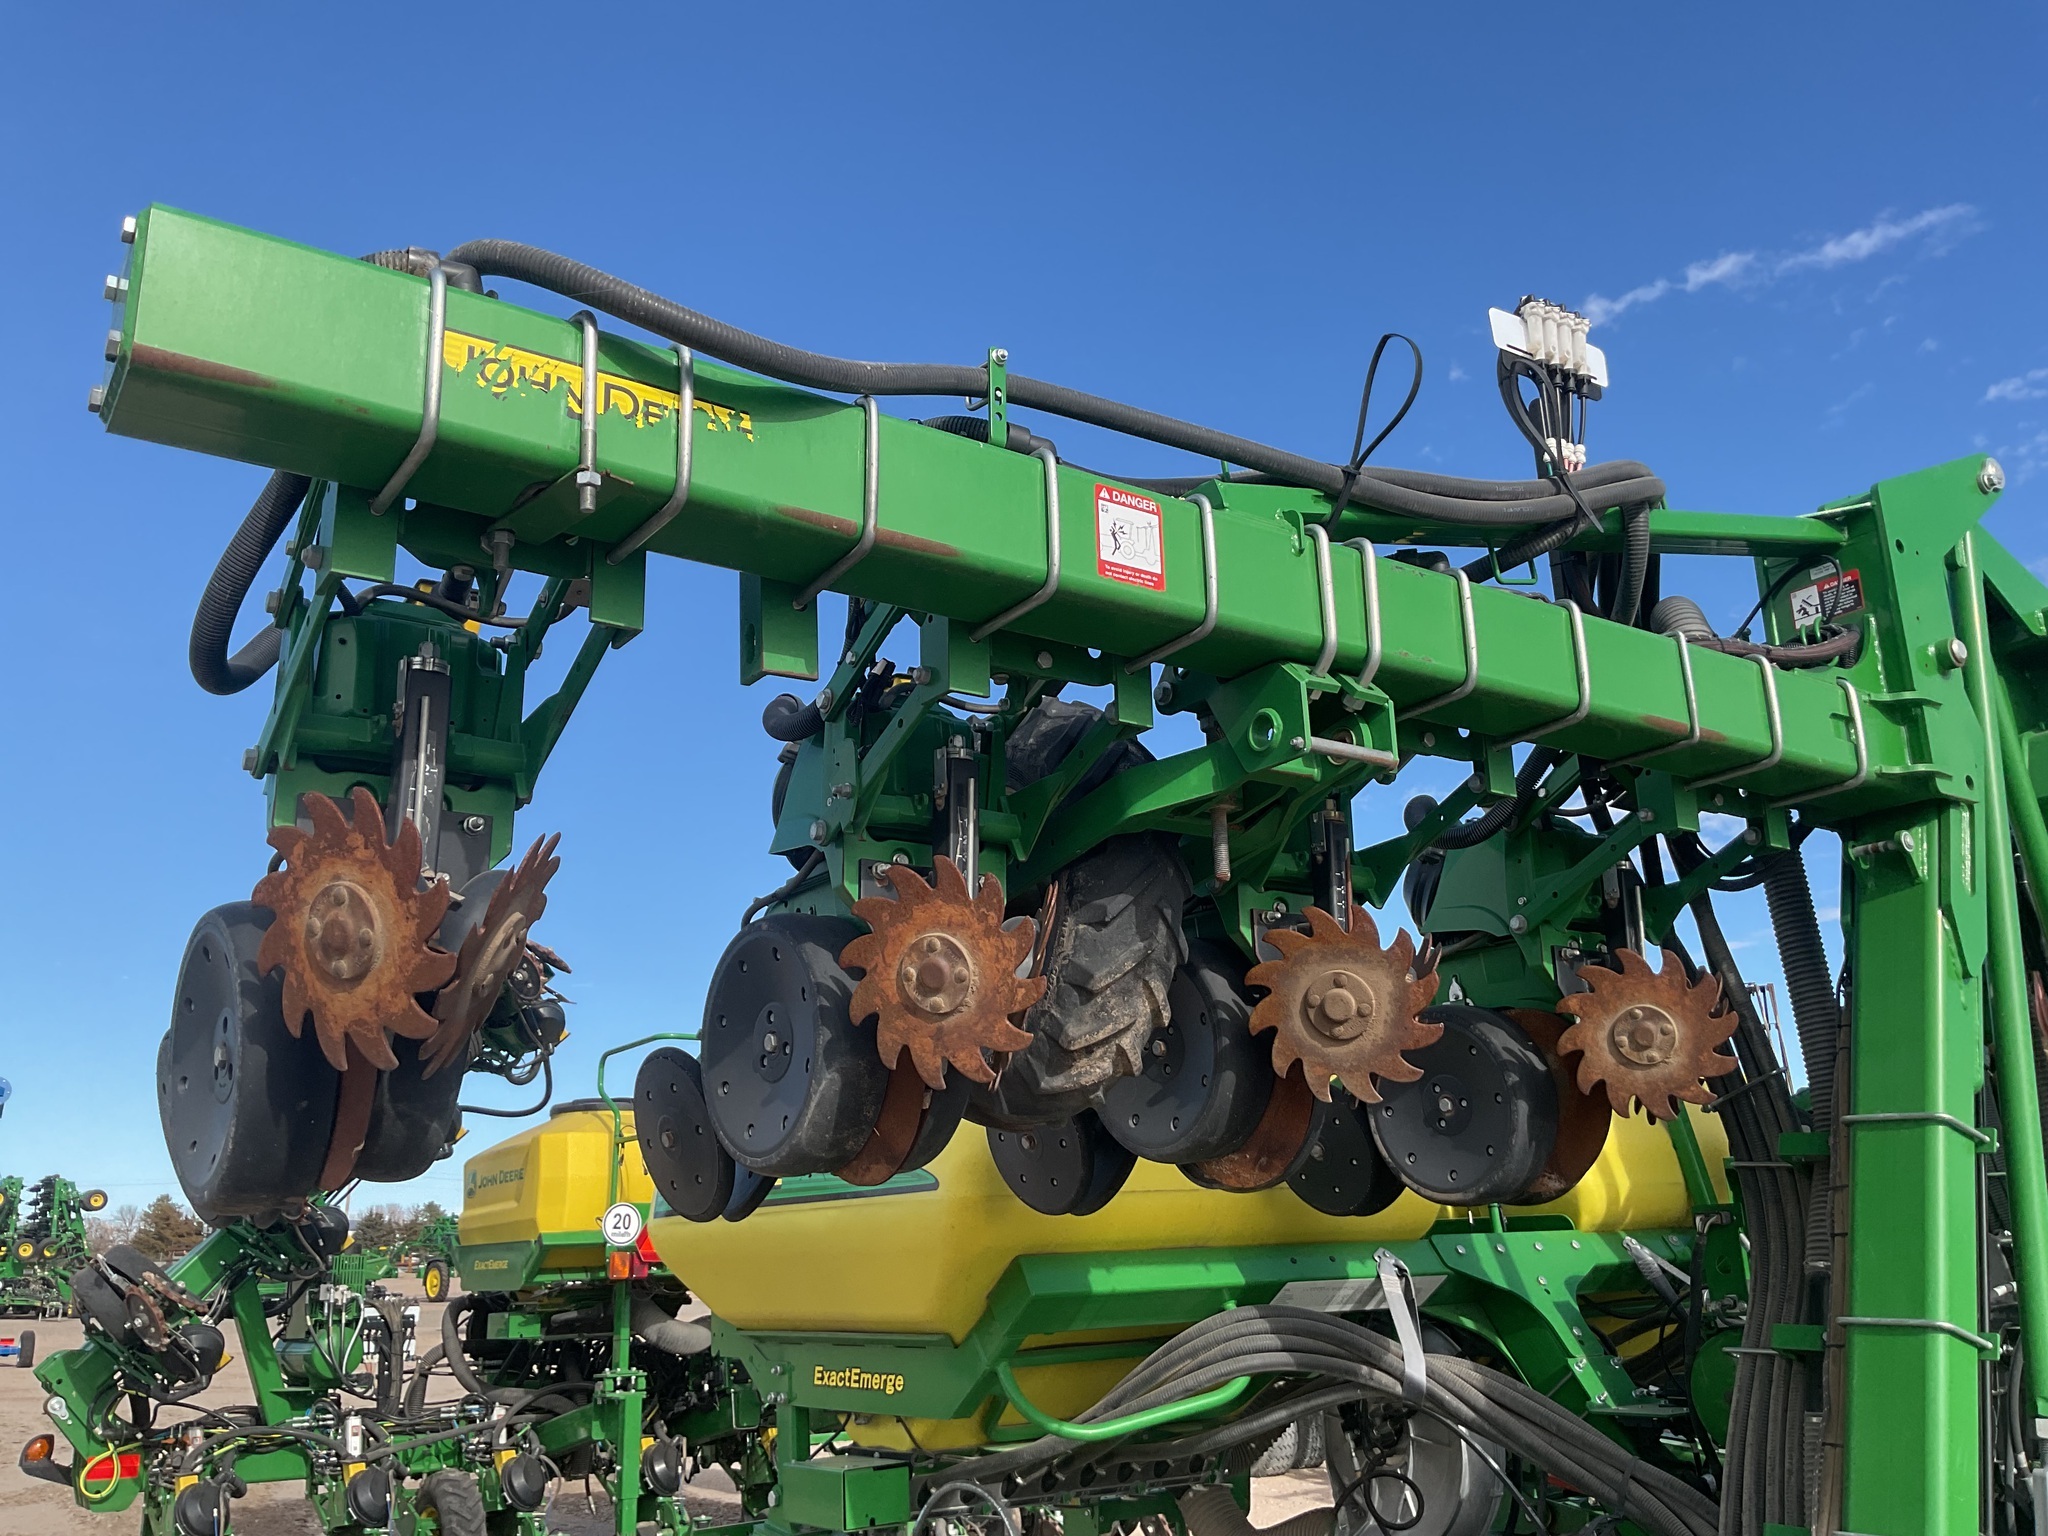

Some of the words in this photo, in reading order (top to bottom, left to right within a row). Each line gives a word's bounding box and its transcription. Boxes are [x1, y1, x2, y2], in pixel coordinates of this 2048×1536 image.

[1112, 491, 1157, 512] DANGER
[1829, 575, 1852, 587] DAER
[478, 1173, 498, 1189] JOHN
[498, 1167, 525, 1185] DEERE
[612, 1212, 632, 1230] 20
[813, 1365, 905, 1395] ExactEmerge
